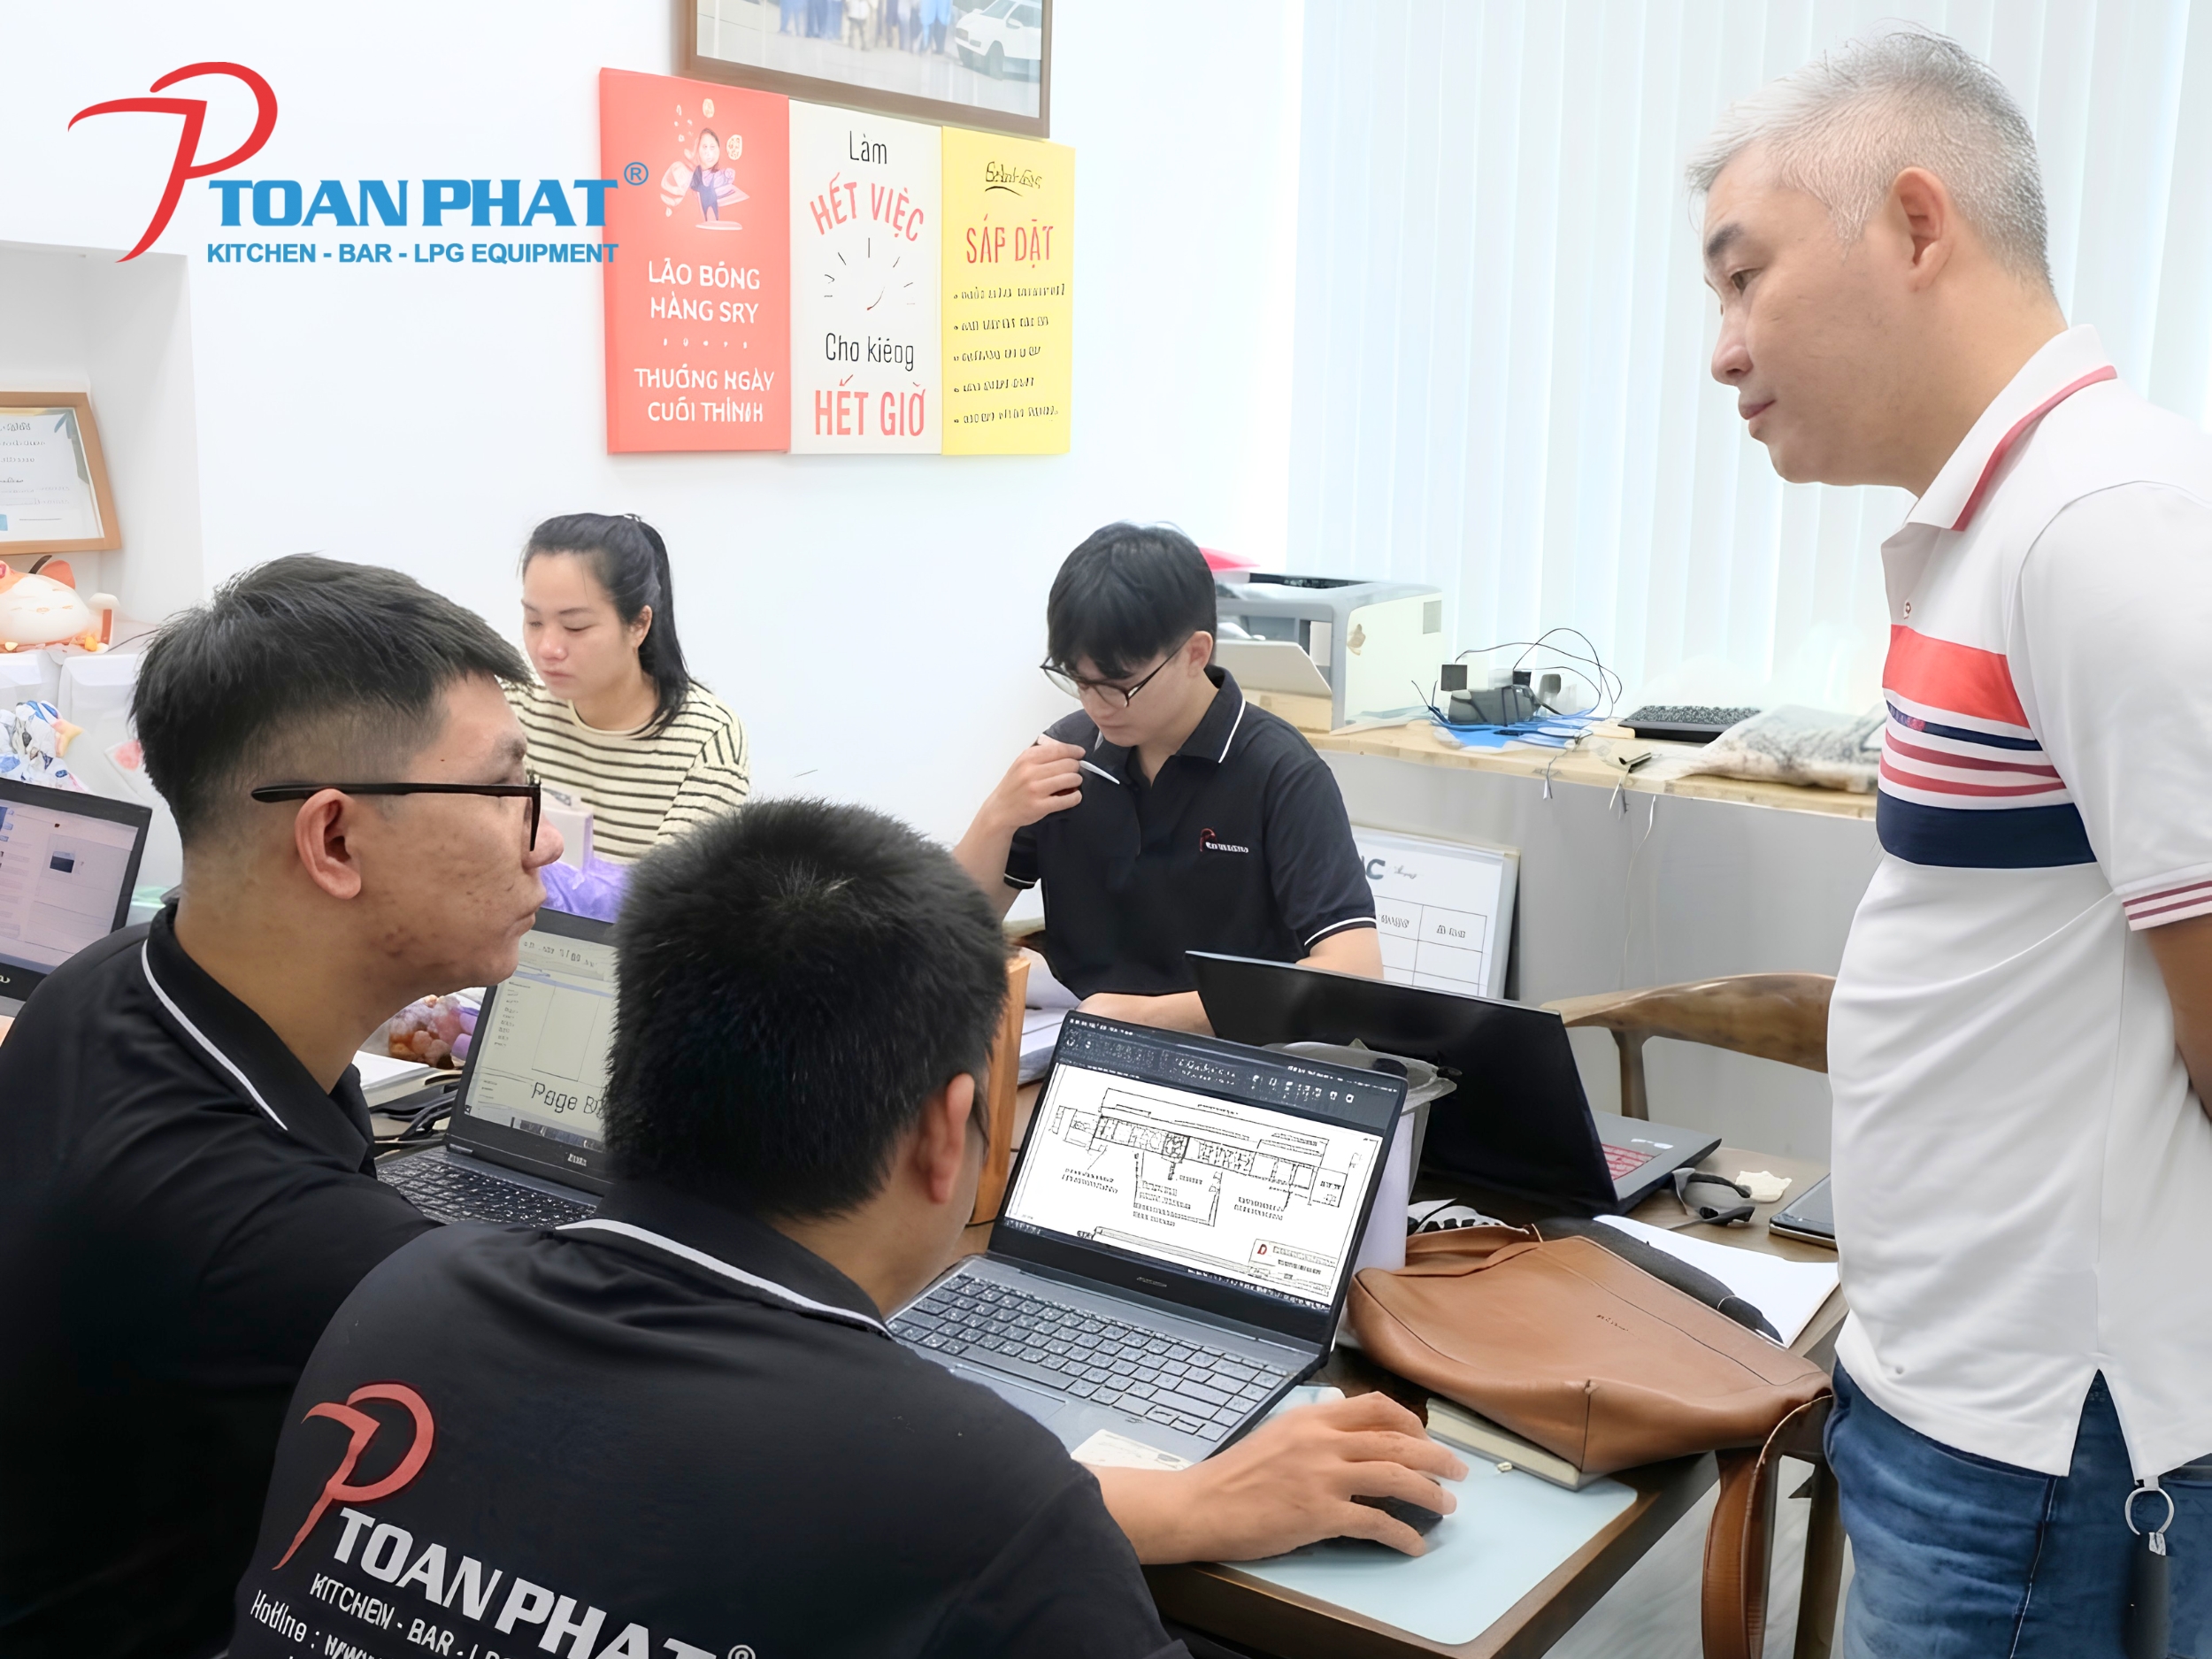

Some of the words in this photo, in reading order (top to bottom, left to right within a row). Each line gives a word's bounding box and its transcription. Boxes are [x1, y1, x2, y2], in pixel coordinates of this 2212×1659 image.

[849, 130, 887, 165] Làm
[826, 333, 859, 362] Cho
[334, 1506, 503, 1622] TOAN
[406, 1617, 455, 1656] BAR
